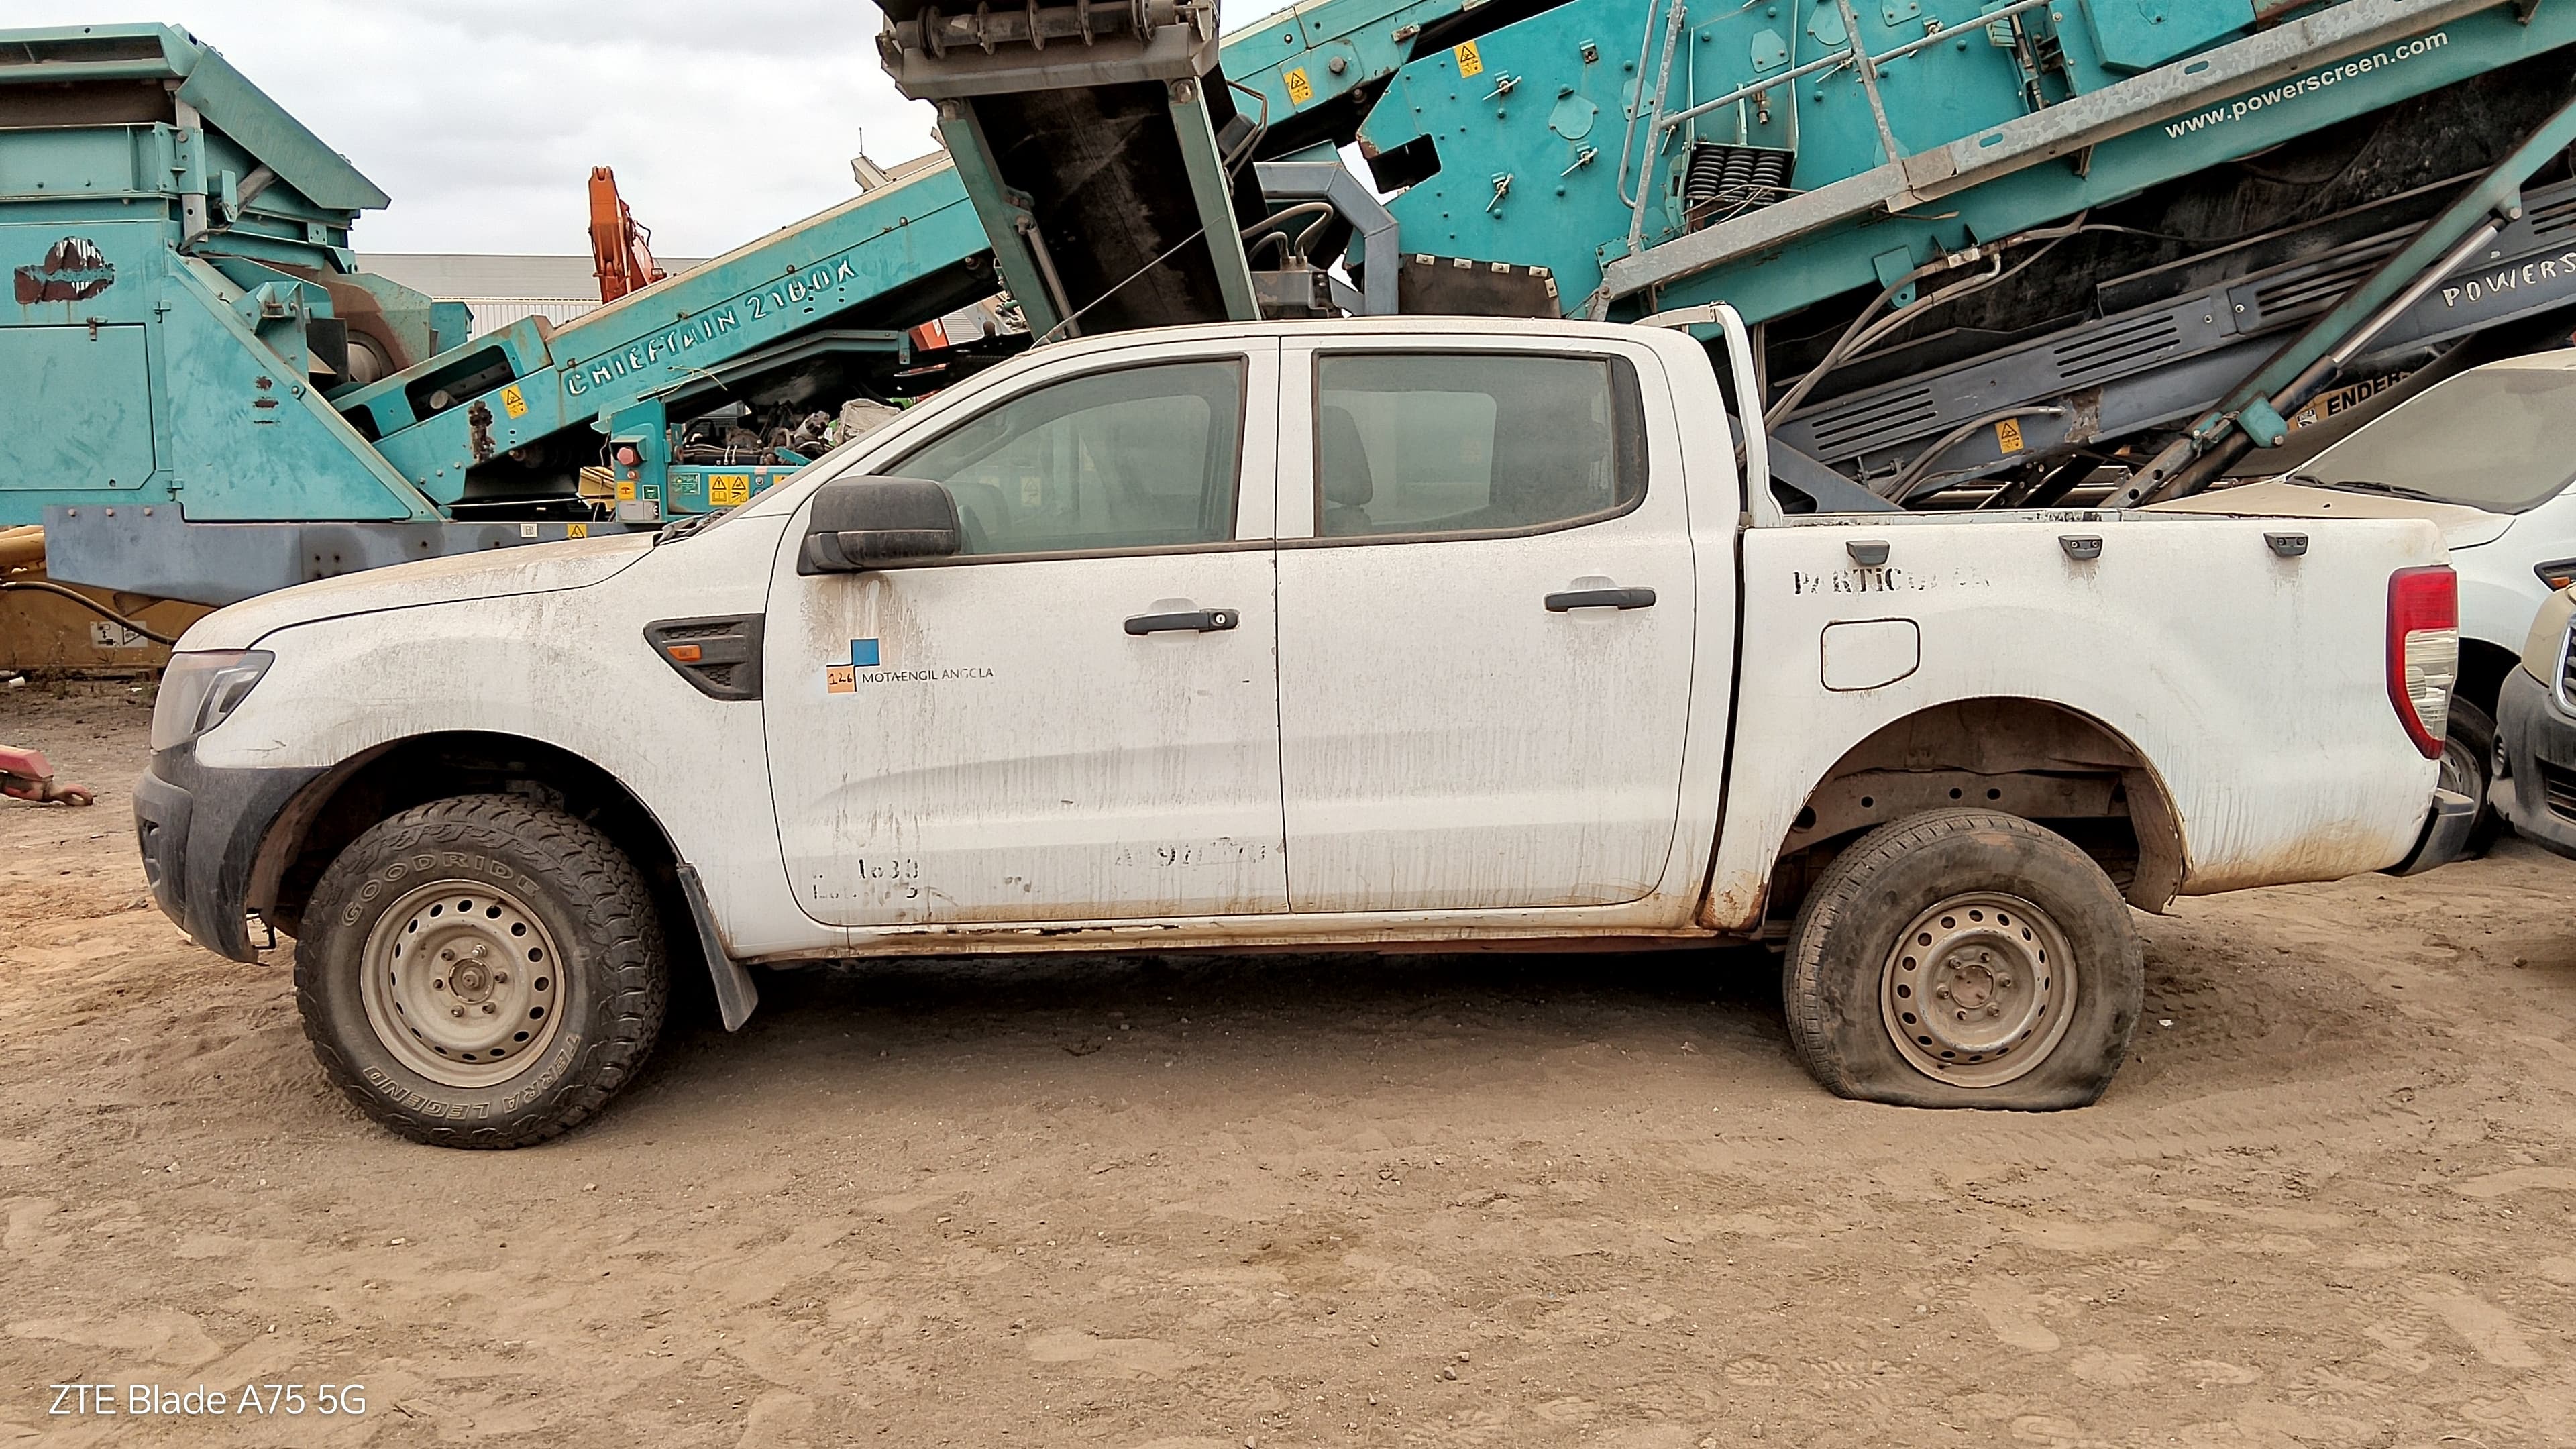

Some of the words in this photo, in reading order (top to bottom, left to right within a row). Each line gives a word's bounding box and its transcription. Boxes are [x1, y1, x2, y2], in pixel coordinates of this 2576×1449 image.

[2165, 31, 2449, 138] www.powerscreen.com
[564, 305, 740, 396] CHIEFTAIN
[341, 851, 541, 926] GOODRIDE
[363, 1066, 490, 1120] LEGEND
[503, 1033, 580, 1114] TERRA
